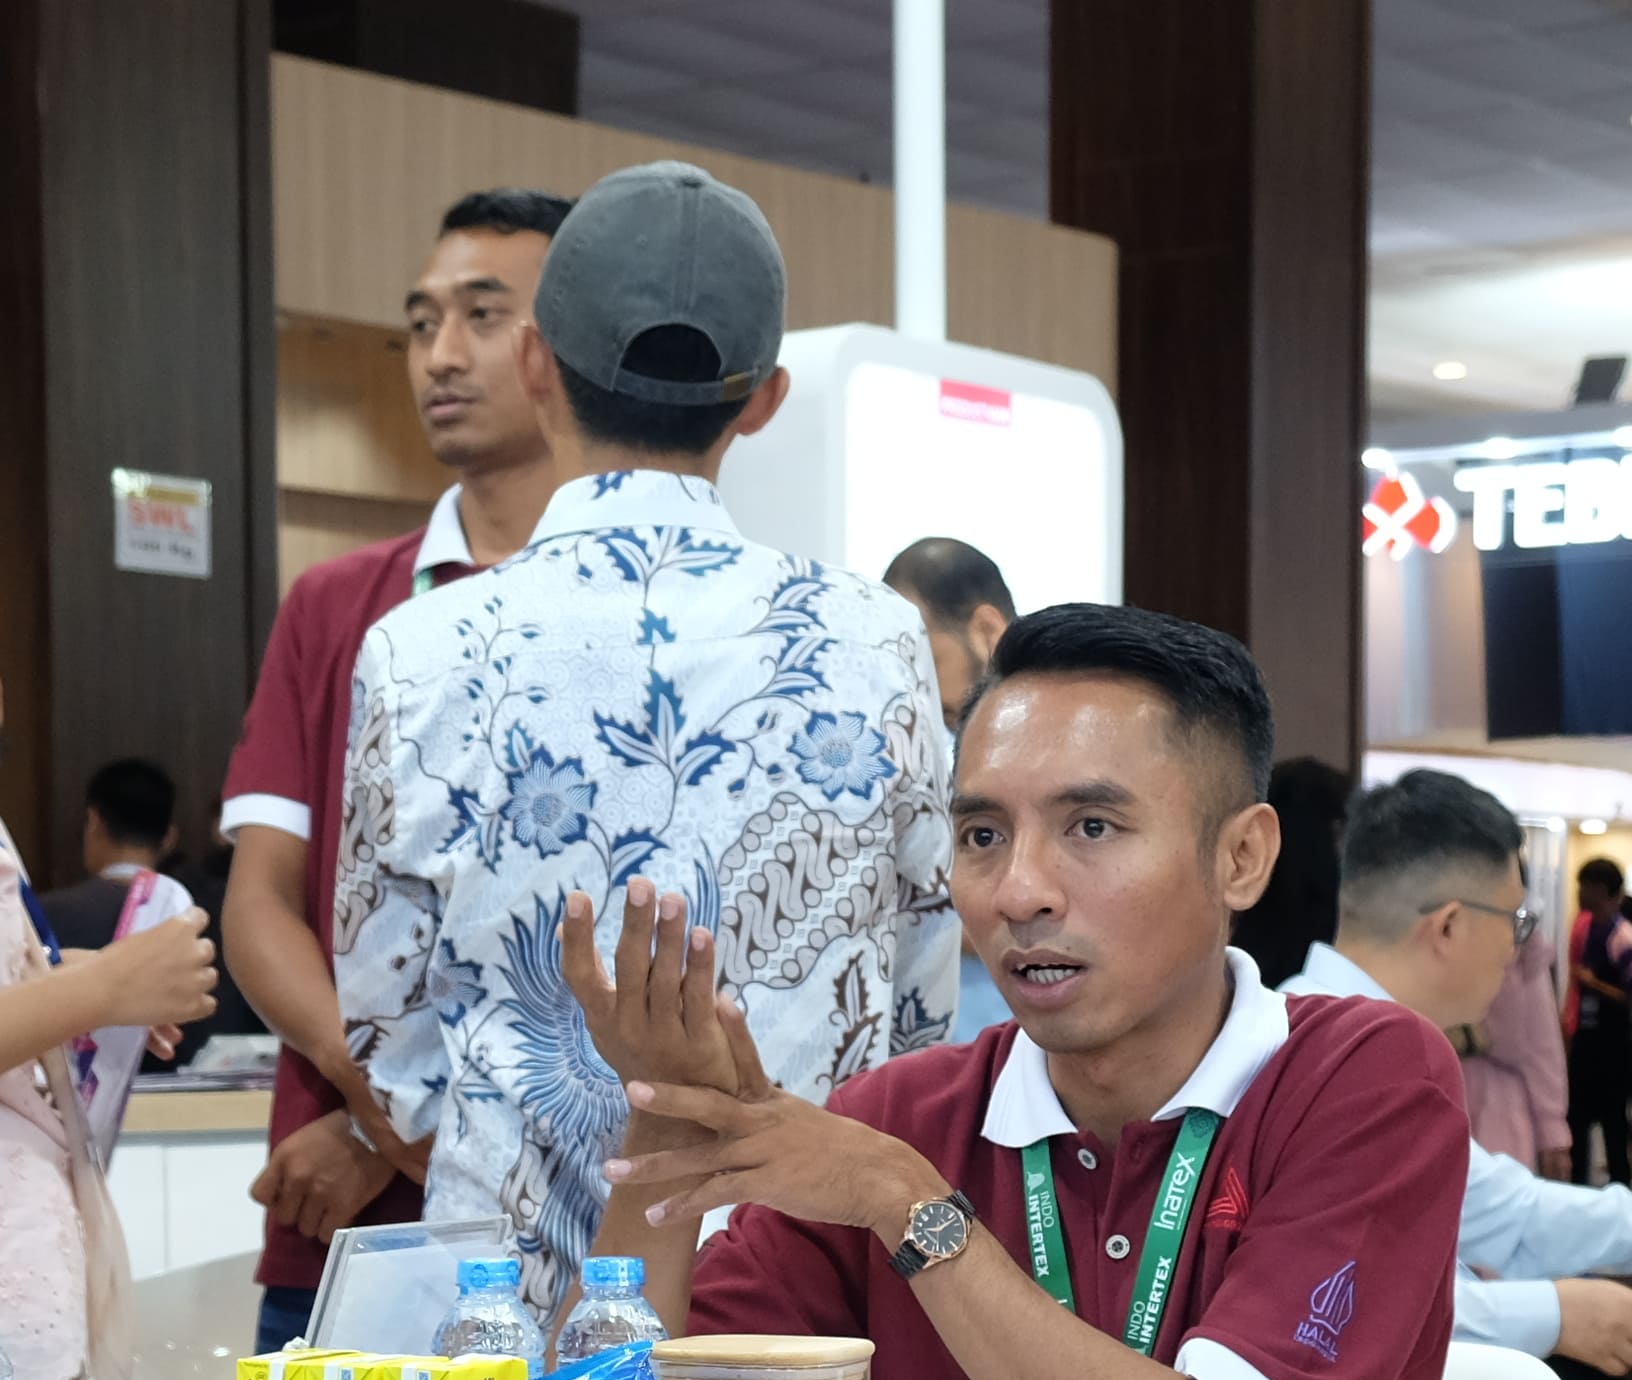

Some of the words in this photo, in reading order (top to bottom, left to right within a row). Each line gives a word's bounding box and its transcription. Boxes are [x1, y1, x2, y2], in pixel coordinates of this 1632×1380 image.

[1028, 1194, 1051, 1278] INTERTEX
[1040, 1190, 1055, 1229] INDO
[1127, 1300, 1146, 1341] INDO
[1139, 1256, 1172, 1345] INTERTEX
